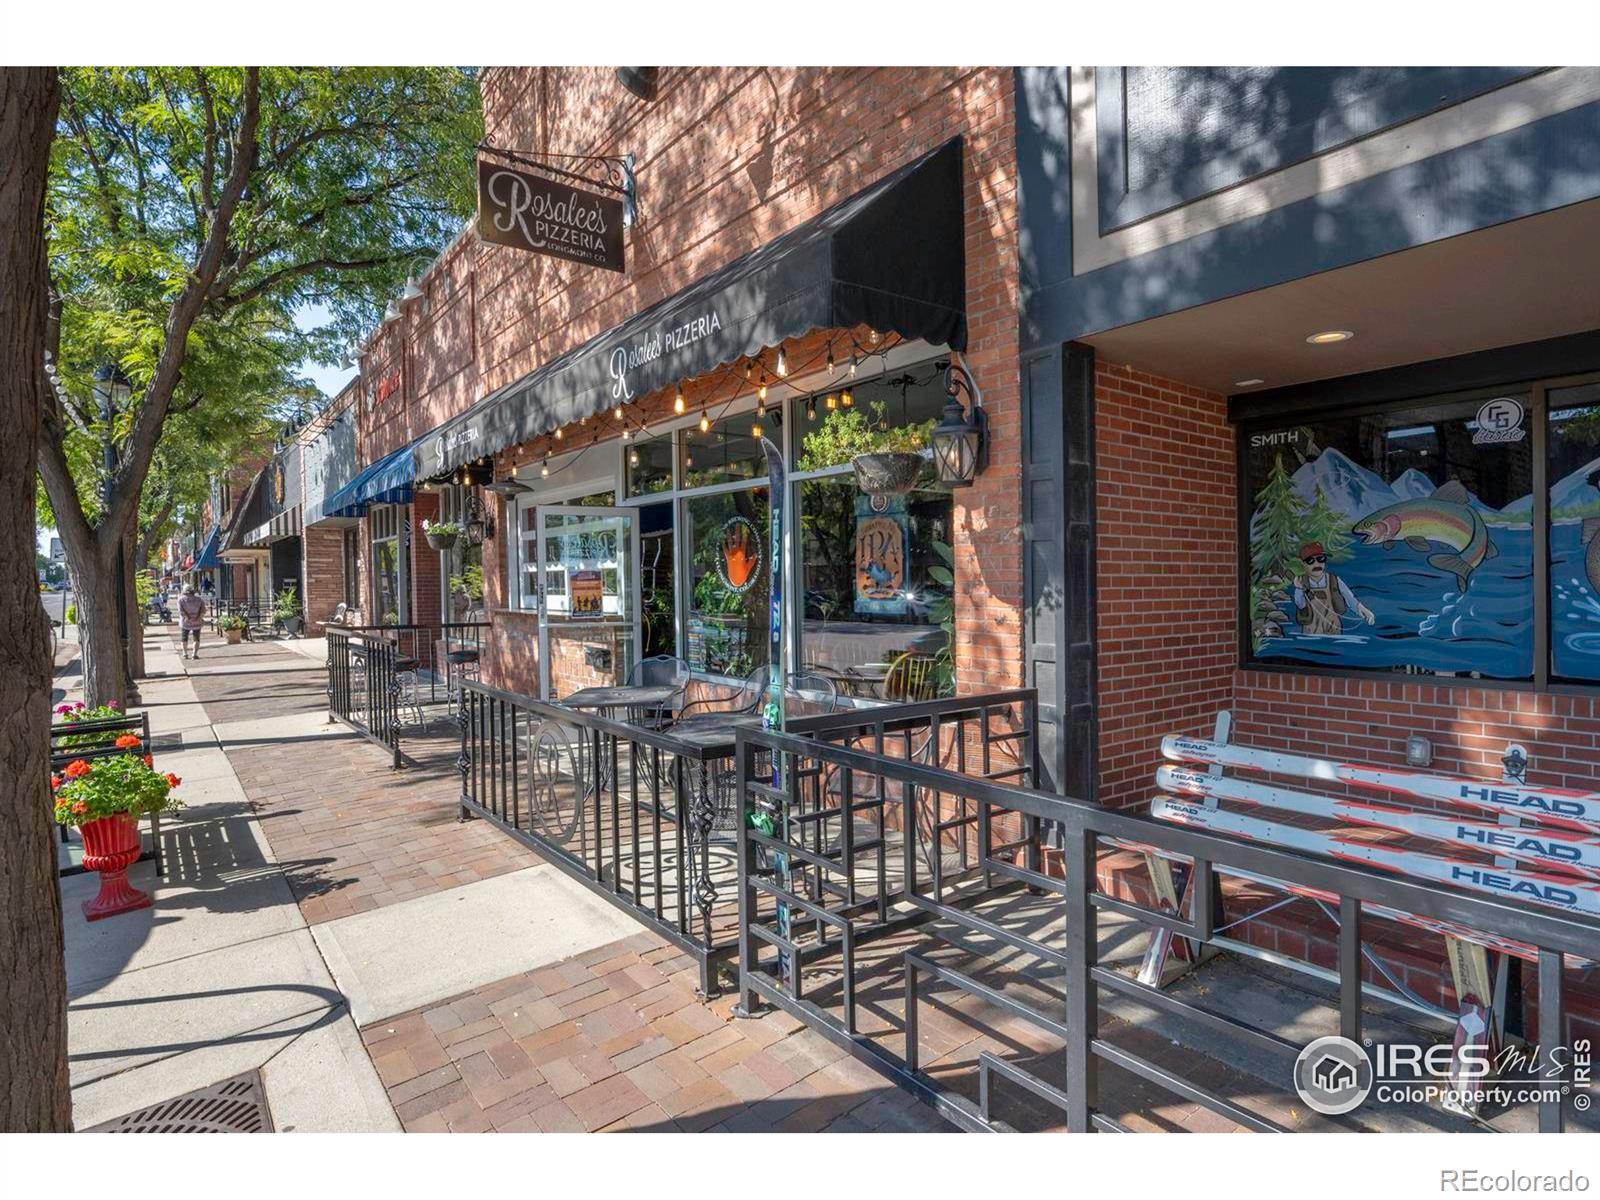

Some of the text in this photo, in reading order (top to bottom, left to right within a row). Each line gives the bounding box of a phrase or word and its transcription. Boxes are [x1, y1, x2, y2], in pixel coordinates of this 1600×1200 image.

[488, 171, 607, 248] Rosalee's
[536, 221, 606, 251] PIZZERIA
[610, 310, 721, 399] Rosalee's PIZZERIA
[1251, 431, 1298, 447] SMITH
[1174, 741, 1208, 751] HEAD
[1171, 773, 1204, 784] HEAD
[1165, 803, 1198, 815] HEAD
[1460, 785, 1585, 816] HEAD
[1457, 826, 1582, 861] HEAD
[1452, 866, 1577, 905] HEAD
